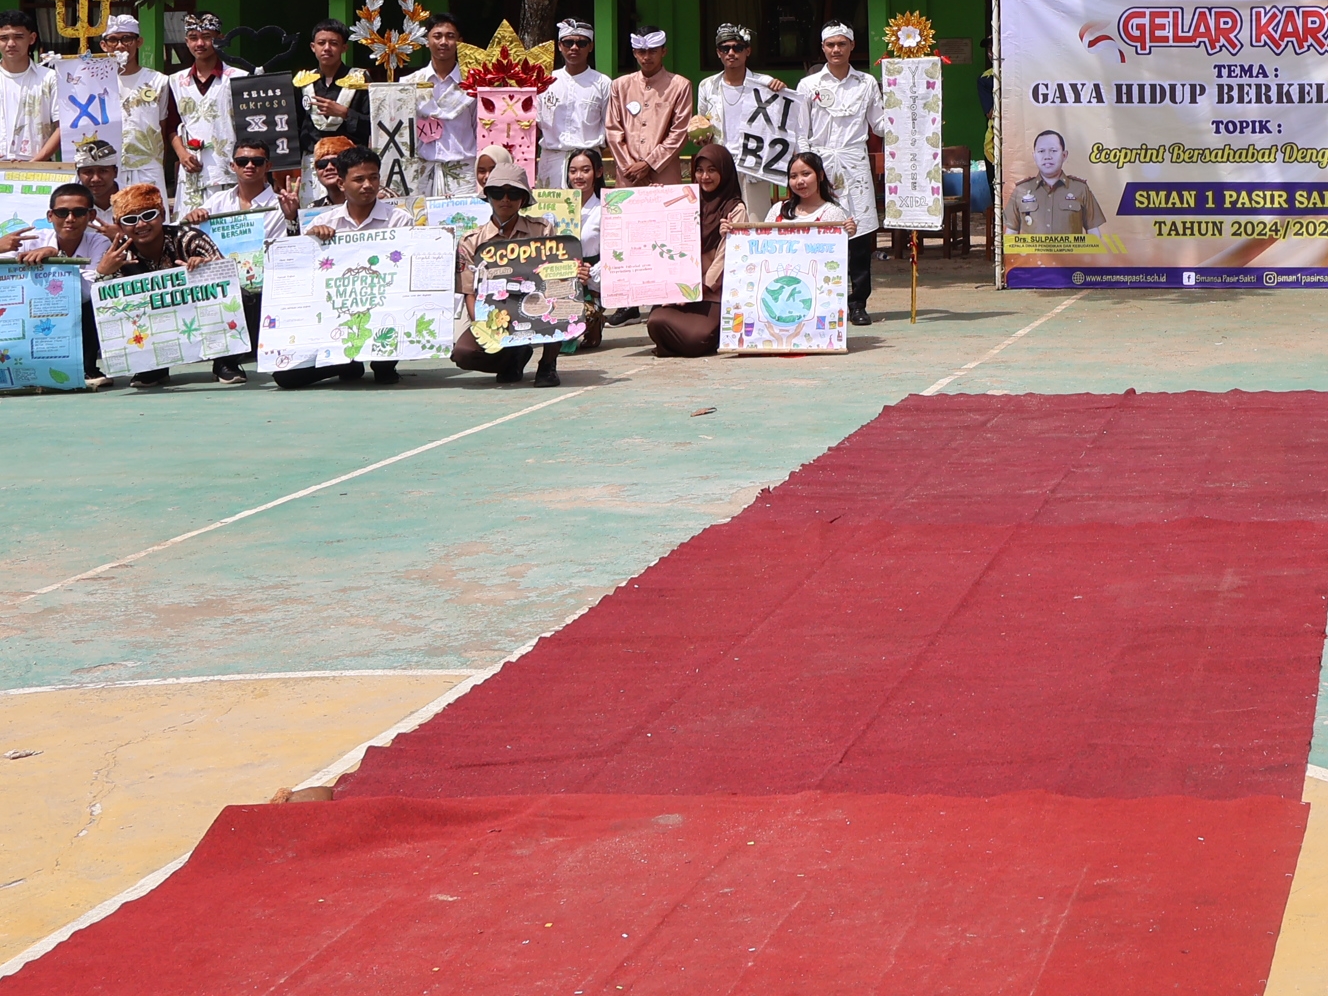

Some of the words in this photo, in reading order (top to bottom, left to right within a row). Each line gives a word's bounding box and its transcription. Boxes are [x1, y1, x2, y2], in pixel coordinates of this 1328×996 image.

[1119, 6, 1243, 55] GELAR
[243, 89, 282, 99] KELAS
[1031, 82, 1106, 105] GAYA
[1114, 83, 1207, 105] HIDUP
[68, 93, 110, 129] XI
[746, 87, 795, 135] XI
[377, 117, 415, 158] XI
[737, 132, 790, 176] B2
[1089, 142, 1165, 169] Ecoprint
[1169, 142, 1278, 165] Bersahabat
[385, 158, 410, 196] A
[429, 199, 468, 210] Harmoni
[1134, 190, 1197, 208] SMAN
[1205, 190, 1216, 208] 1
[1223, 190, 1289, 208] PASIR
[211, 221, 255, 234] KEBERSIHAN
[220, 228, 252, 239] BERSAMA
[1153, 220, 1225, 237] TAHUN
[747, 239, 801, 255] PLASTIC
[804, 243, 837, 254] WASTE
[1014, 235, 1029, 243] Drs.
[1030, 235, 1072, 244] SULPAKAR,
[1073, 235, 1086, 243] MM
[480, 239, 569, 266] ecoprint
[35, 271, 72, 279] ECOPRINT
[325, 271, 398, 289] ECOPRINT
[1085, 273, 1167, 285] www.smansapasti.sch.id
[1195, 275, 1221, 283] Smansa
[1222, 275, 1238, 283] Pasir
[1239, 275, 1257, 283] Sakti
[98, 270, 187, 301] INFOGRAFIS
[335, 284, 386, 299] MAGIC
[149, 280, 231, 310] ECOPRINT
[332, 295, 387, 310] LEAVES
